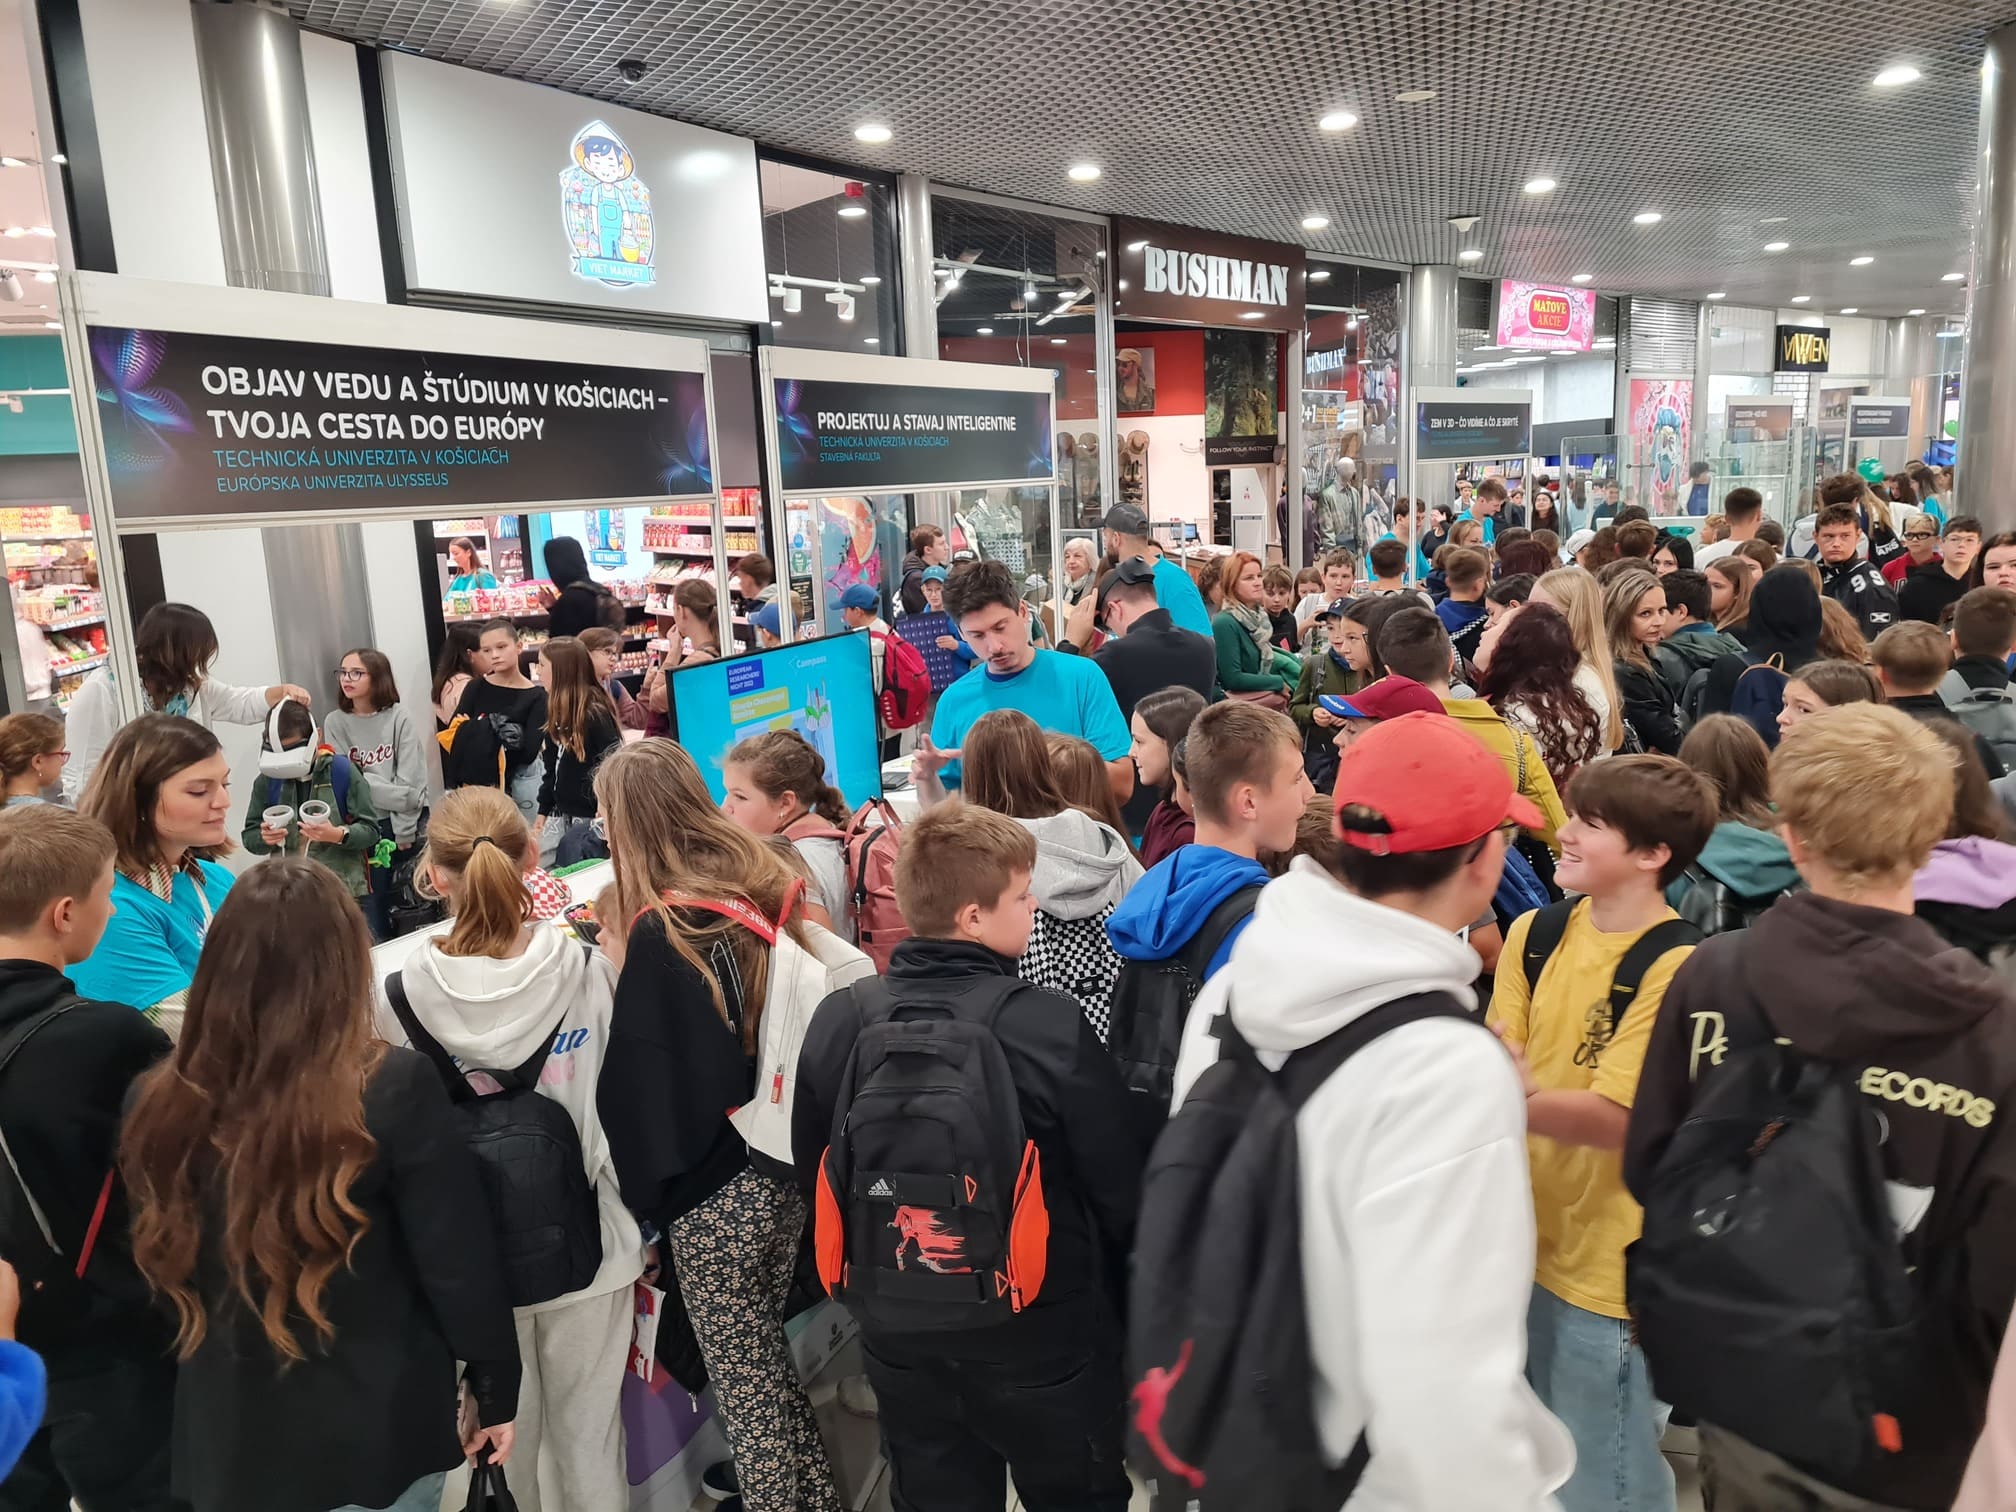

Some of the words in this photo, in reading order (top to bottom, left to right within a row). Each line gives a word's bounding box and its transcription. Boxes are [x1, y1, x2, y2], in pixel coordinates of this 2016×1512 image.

[588, 263, 610, 275] VIET
[611, 264, 644, 277] MARKET
[1144, 246, 1289, 306] BUSHMAN
[1537, 313, 1563, 327] AKCIE
[1306, 348, 1347, 374] BUSHMAN
[201, 365, 305, 397] OBJAV
[312, 371, 392, 400] VEDU
[400, 376, 418, 401] A
[422, 370, 530, 405] ŠTÚDIUM
[533, 382, 549, 406] V
[554, 379, 655, 410] KOŠICIACH
[206, 410, 312, 439] TVOJA
[318, 411, 405, 440] CESTA
[410, 414, 449, 440] DO
[454, 410, 545, 440] EURÓPY
[817, 411, 890, 431] PROJEKTUJ
[892, 414, 901, 431] A
[903, 413, 945, 432] STAVAJ
[946, 414, 1017, 432] INTELIGENTNE
[865, 436, 907, 448] UNIVERZITA
[212, 446, 321, 468] TECHNICKÁ
[324, 449, 418, 467] UNIVERZITA
[419, 449, 431, 465] V
[435, 446, 510, 465] KOŠICIACH
[855, 451, 881, 462] FAKULTA
[216, 474, 301, 493] EURÓPSKA
[304, 474, 385, 491] UNIVERZITA
[386, 472, 449, 488] ULYSSEUS
[1851, 574, 1866, 593] 9
[1857, 1066, 1996, 1128] ECORDS
